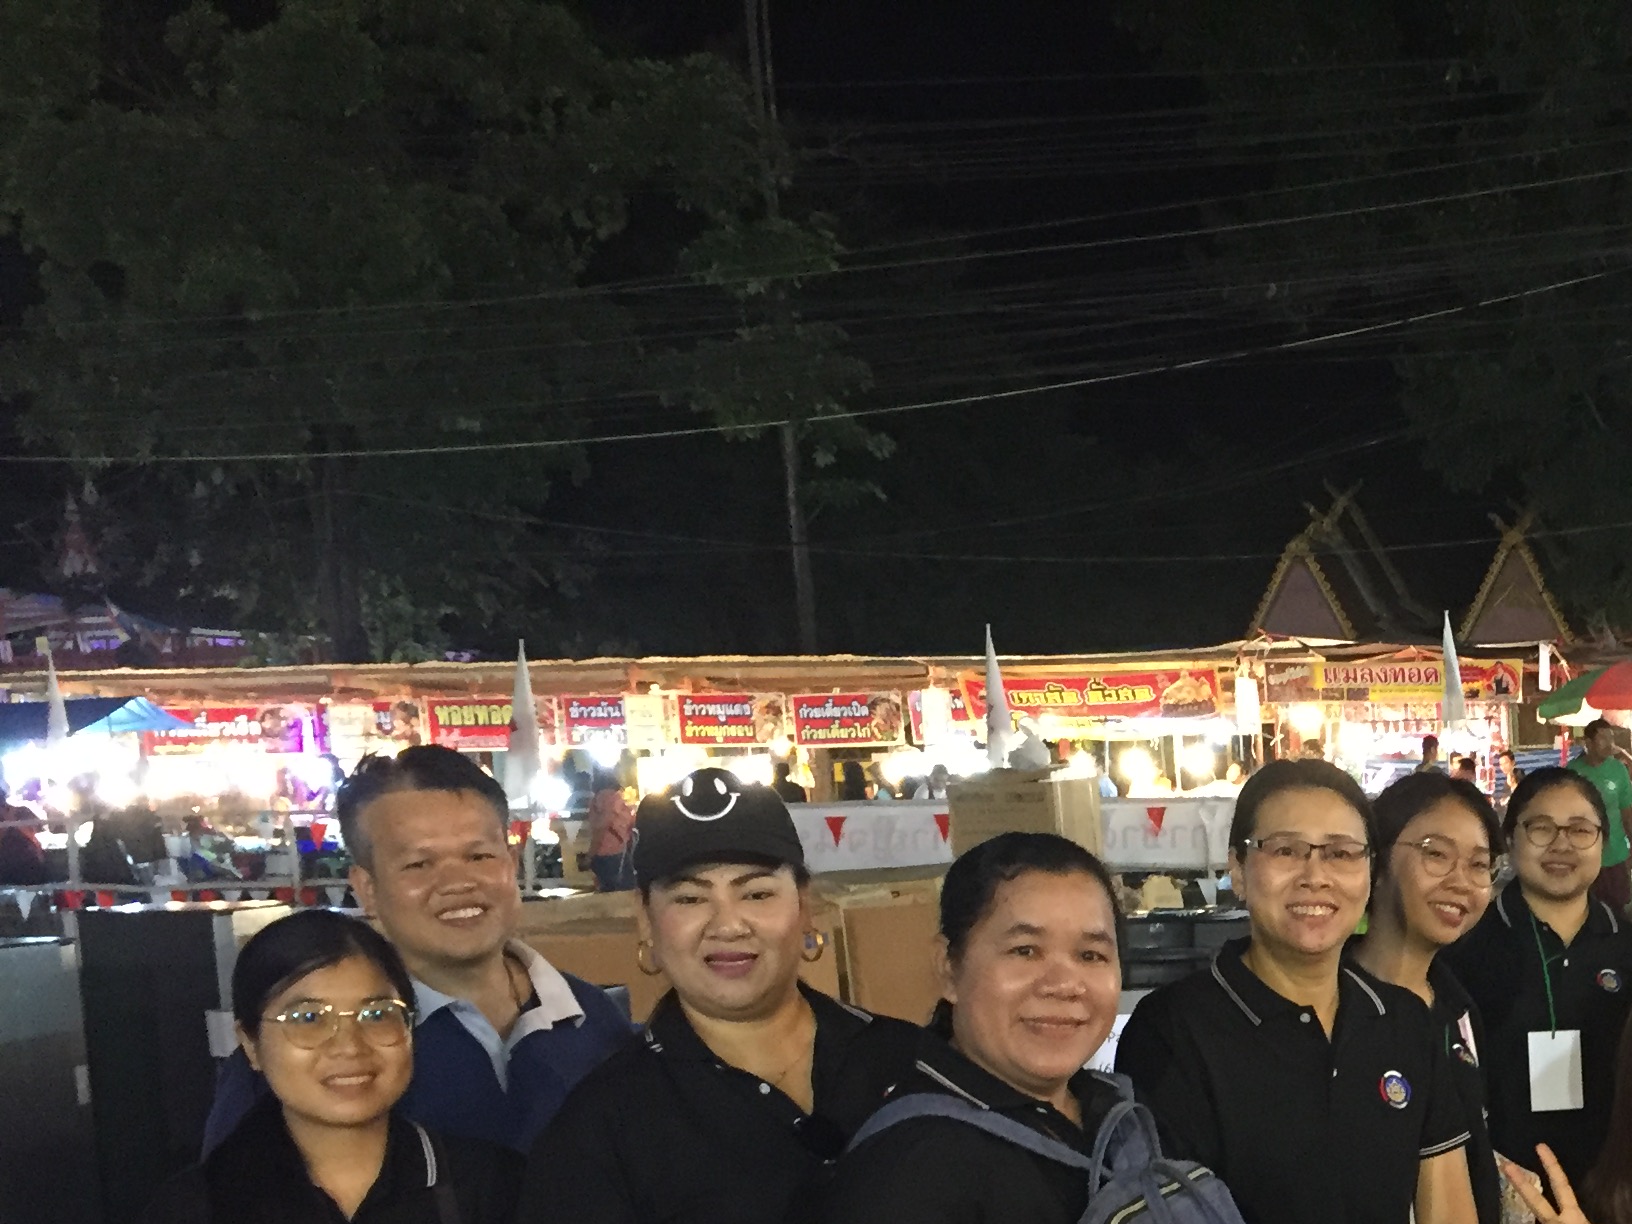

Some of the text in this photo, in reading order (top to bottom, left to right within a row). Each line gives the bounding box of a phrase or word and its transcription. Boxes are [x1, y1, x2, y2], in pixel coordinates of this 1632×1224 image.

[1323, 666, 1441, 685] แมลงทอด
[683, 699, 751, 722] ข้าวหมูแดง
